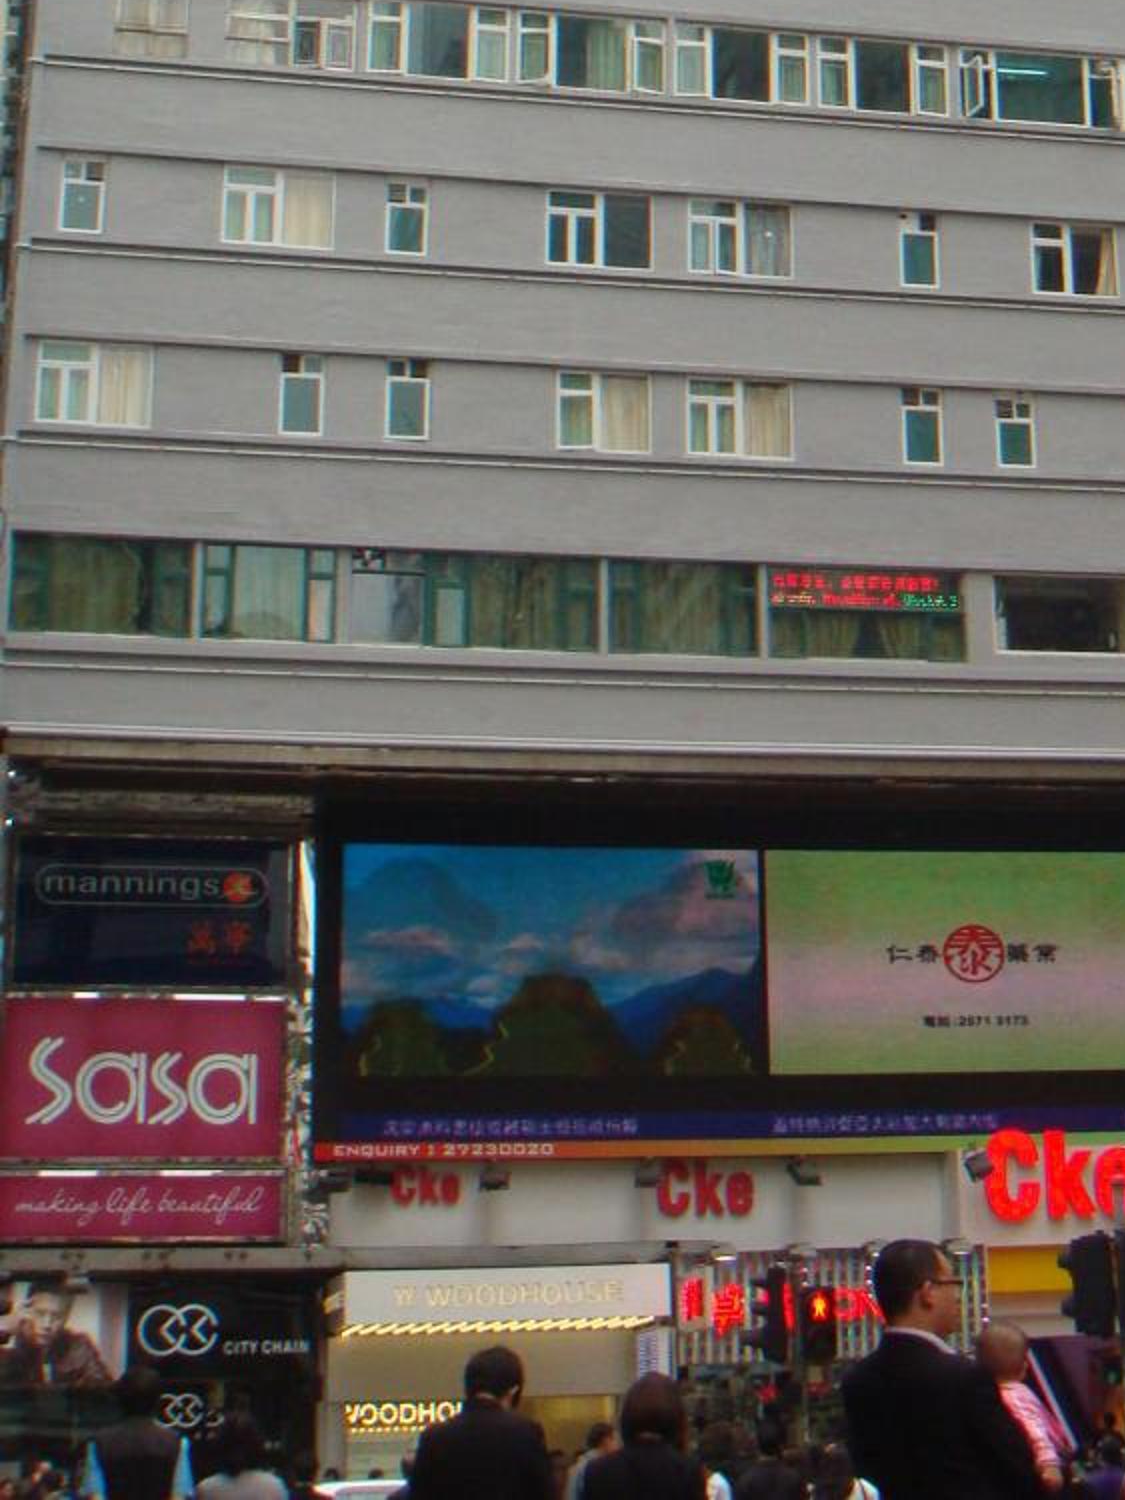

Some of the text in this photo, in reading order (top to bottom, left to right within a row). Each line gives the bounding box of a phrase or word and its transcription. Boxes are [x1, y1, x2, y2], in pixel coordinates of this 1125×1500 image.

[44, 871, 219, 901] mannings
[332, 1143, 420, 1158] ENQUIRY
[442, 1143, 555, 1157] 27230020
[15, 1185, 265, 1228] making life beautiful
[426, 1280, 624, 1307] WOODHOUSE
[223, 1337, 310, 1355] CITY CHAIN
